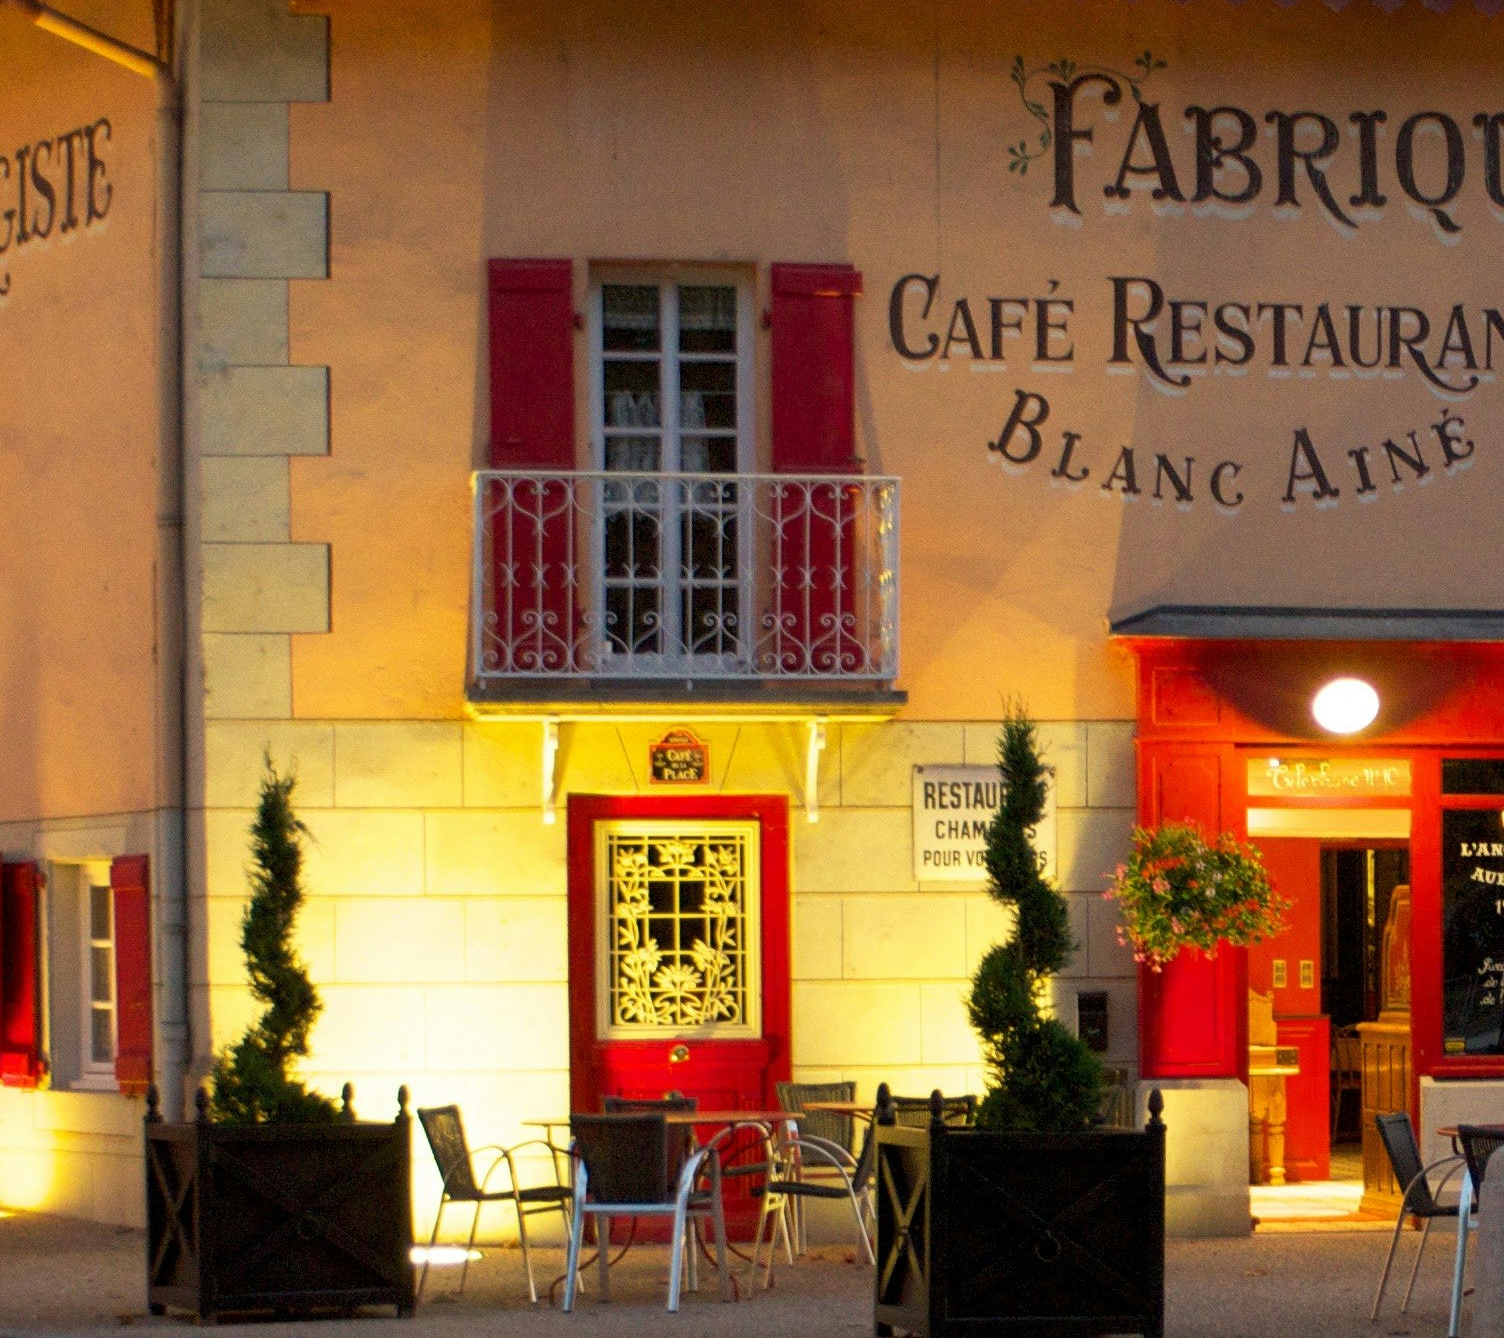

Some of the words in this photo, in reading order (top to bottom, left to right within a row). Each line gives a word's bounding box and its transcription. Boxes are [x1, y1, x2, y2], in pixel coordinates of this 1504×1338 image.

[889, 273, 1075, 361] CAFÉ
[988, 389, 1244, 508] BLANC
[1282, 407, 1475, 503] AINÉ
[923, 781, 1014, 810] RESTAUR
[935, 820, 1037, 840] CHAMS
[923, 849, 961, 867] POUR
